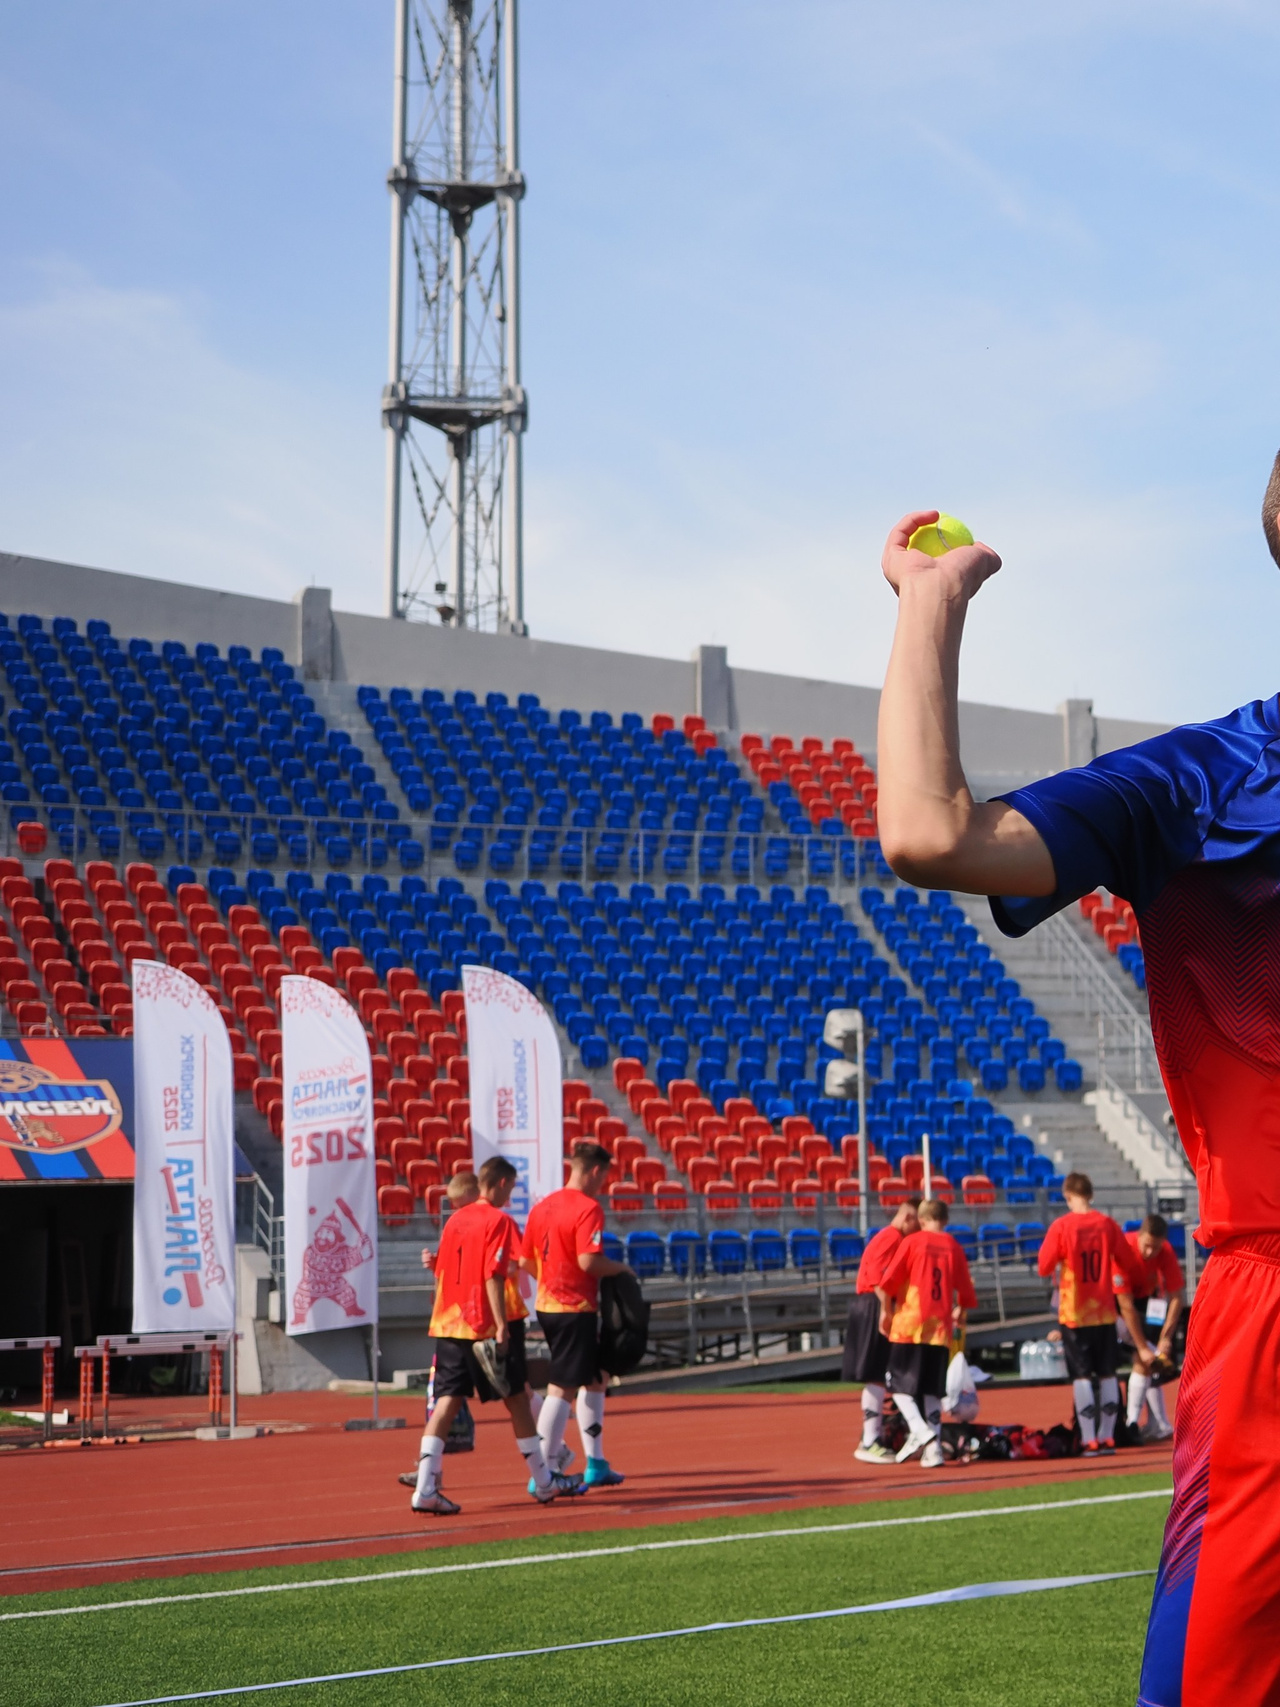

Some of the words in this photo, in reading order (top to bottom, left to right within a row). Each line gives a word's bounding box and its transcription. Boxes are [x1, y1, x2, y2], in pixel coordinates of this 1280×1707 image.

[542, 1230, 550, 1262] 4
[456, 1245, 462, 1285] 1
[1080, 1250, 1102, 1284] 10
[931, 1268, 942, 1301] 3
